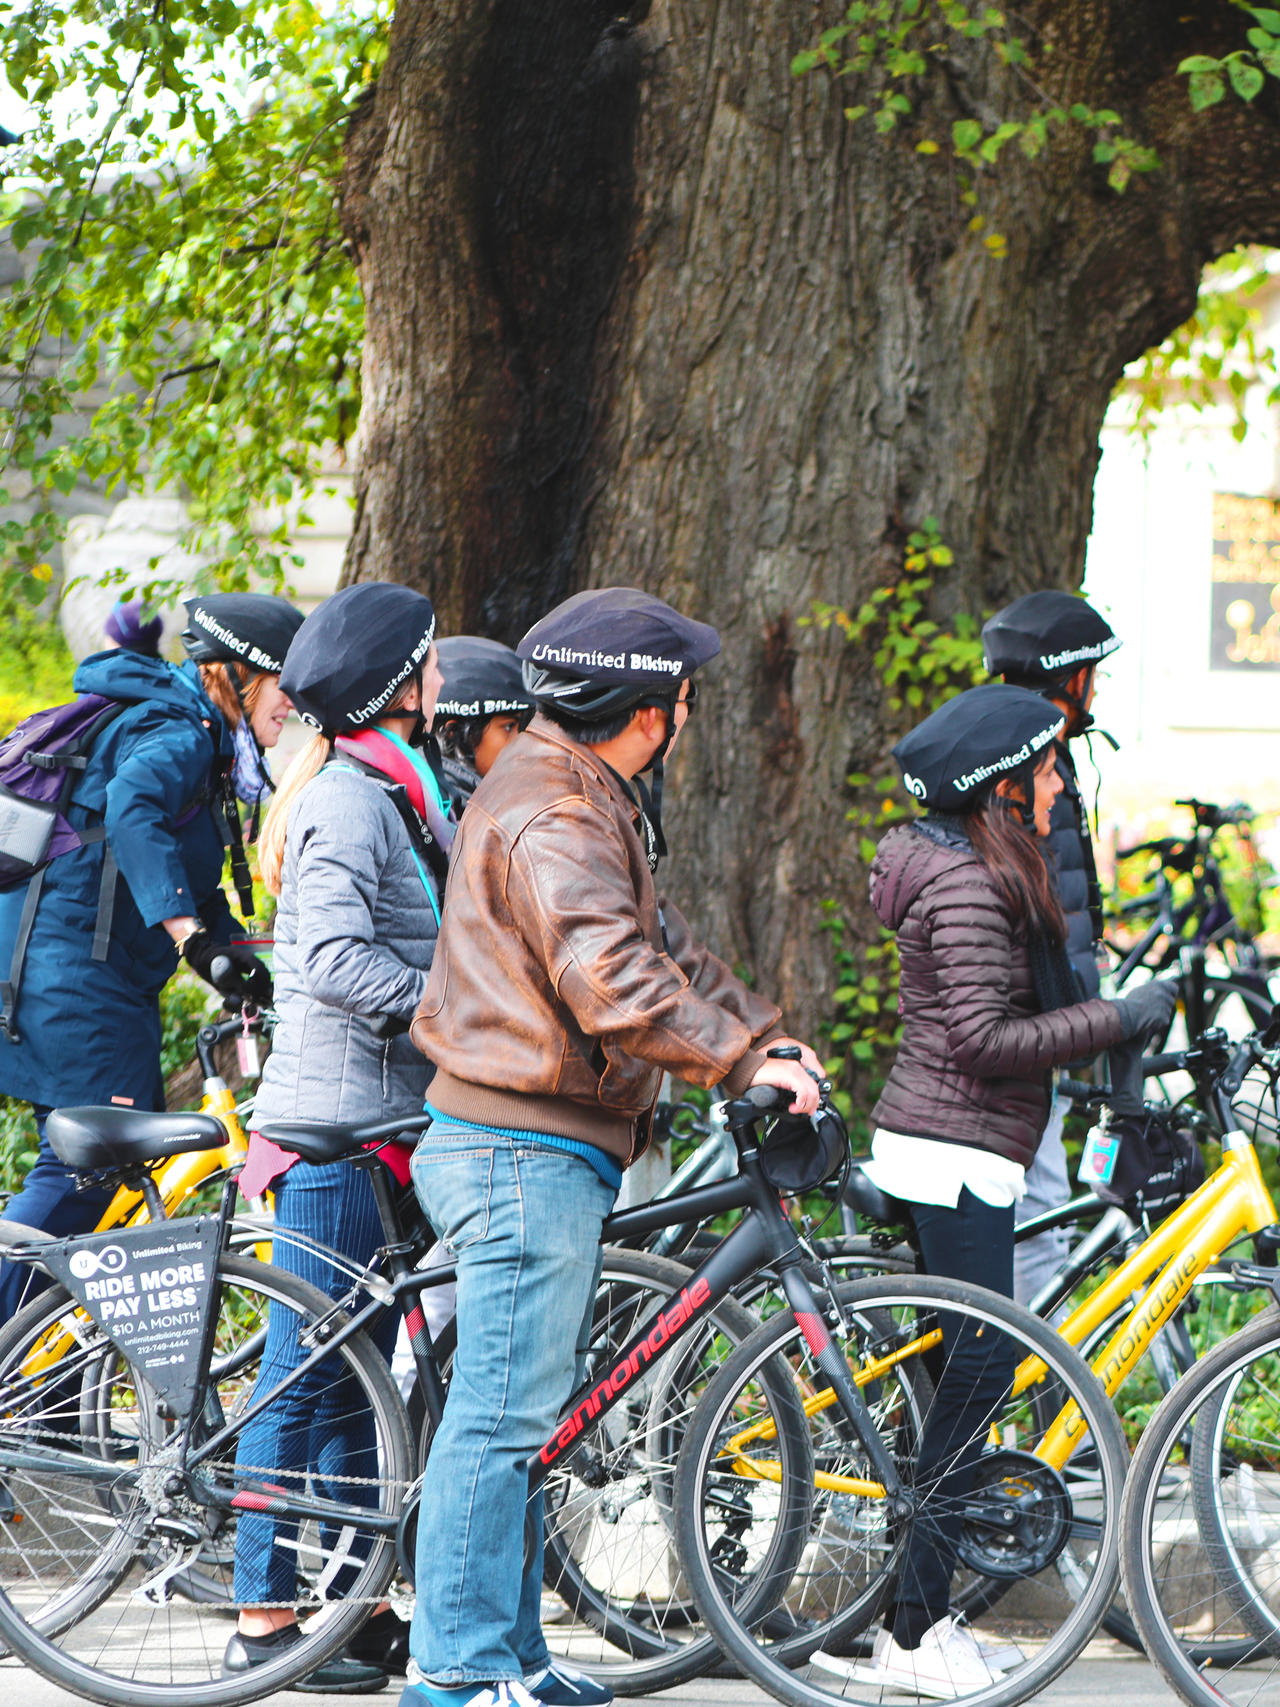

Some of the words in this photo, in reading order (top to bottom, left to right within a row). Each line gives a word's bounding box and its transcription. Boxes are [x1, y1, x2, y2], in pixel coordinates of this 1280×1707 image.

[194, 607, 250, 655] Unlimited
[532, 644, 626, 669] Unlimited
[630, 653, 683, 676] Biking
[347, 660, 413, 725] Unlimited
[953, 744, 1031, 792] Unlimited
[132, 1244, 175, 1259] Unlimited
[176, 1241, 202, 1252] Biking
[84, 1275, 136, 1300] RIDE
[140, 1263, 206, 1291] MORE
[100, 1296, 140, 1321] PAY
[147, 1287, 197, 1312] LESS
[112, 1322, 134, 1337] $10
[137, 1320, 148, 1332] A
[150, 1310, 200, 1330] MONTH
[124, 1328, 199, 1346] unlimitedbiking.com
[539, 1277, 712, 1465] cannondale
